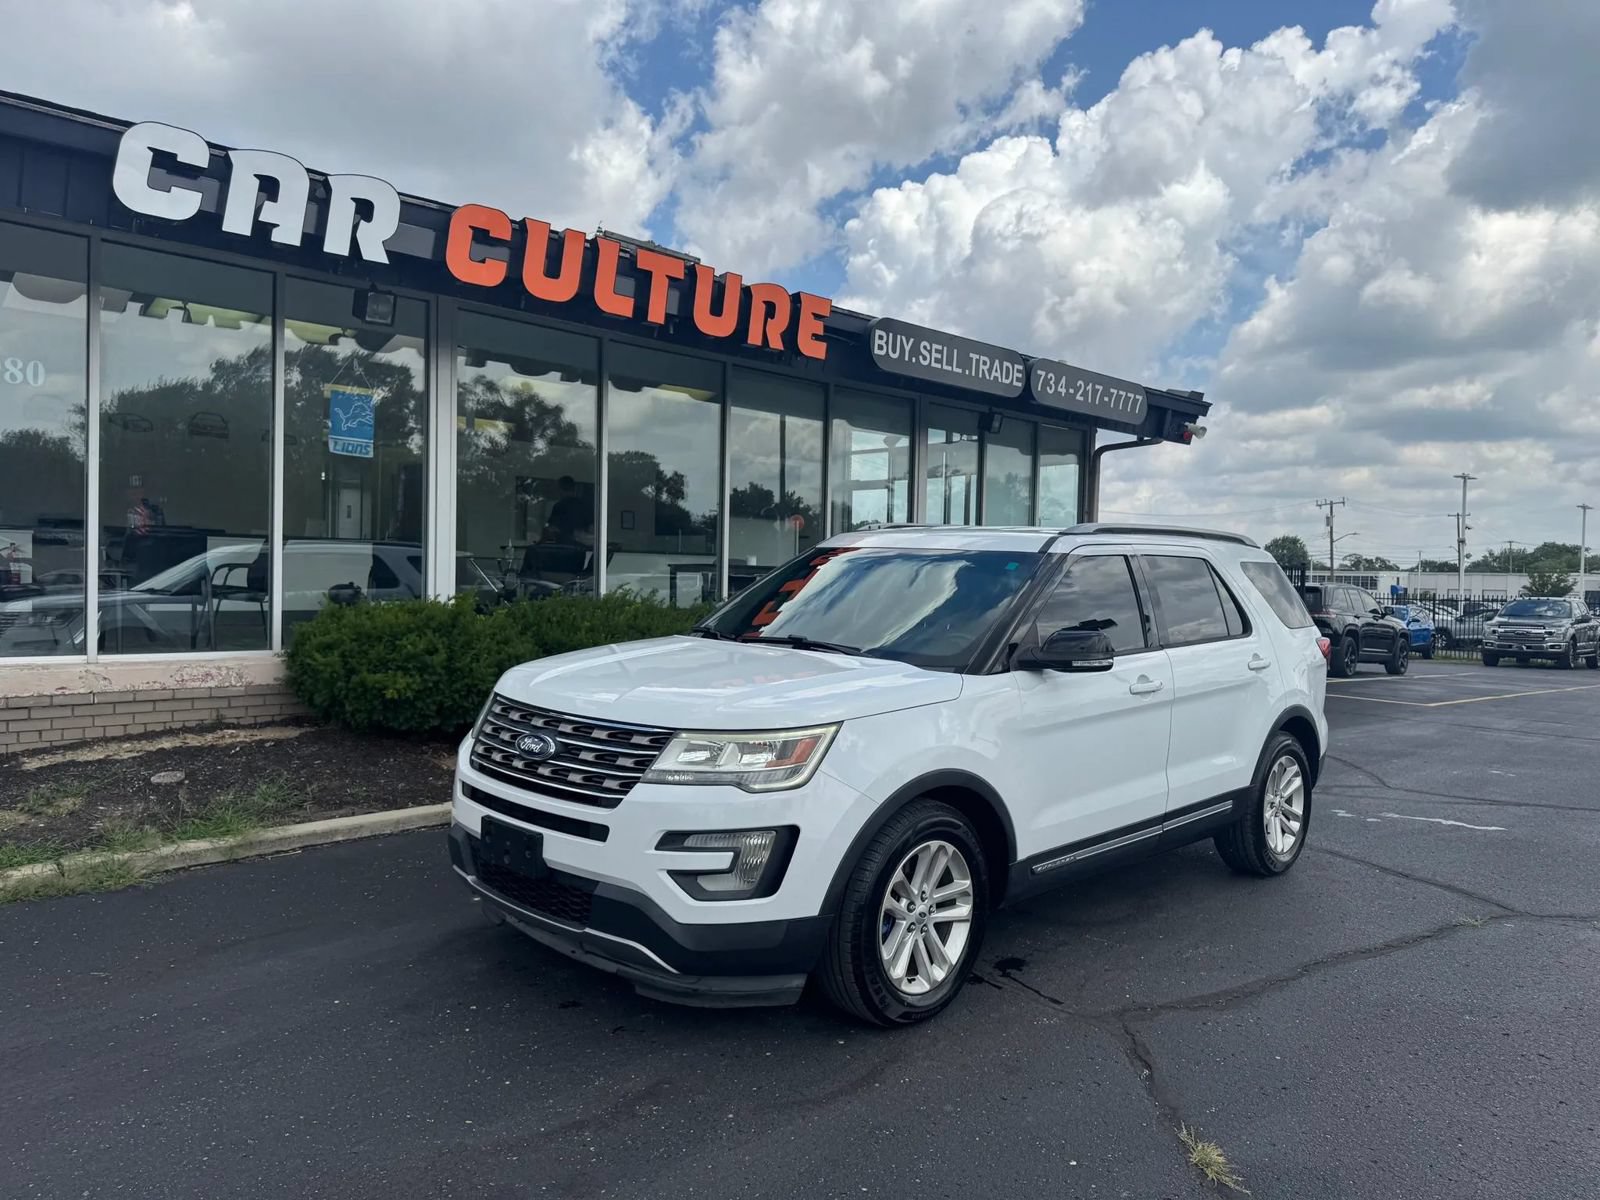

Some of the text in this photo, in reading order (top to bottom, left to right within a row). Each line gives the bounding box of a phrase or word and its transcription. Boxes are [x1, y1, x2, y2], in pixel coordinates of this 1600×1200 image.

[112, 121, 833, 360] CAR CULTURE
[0, 357, 46, 387] 80
[1037, 369, 1143, 414] 734-217-7777
[520, 736, 544, 753] Ford
